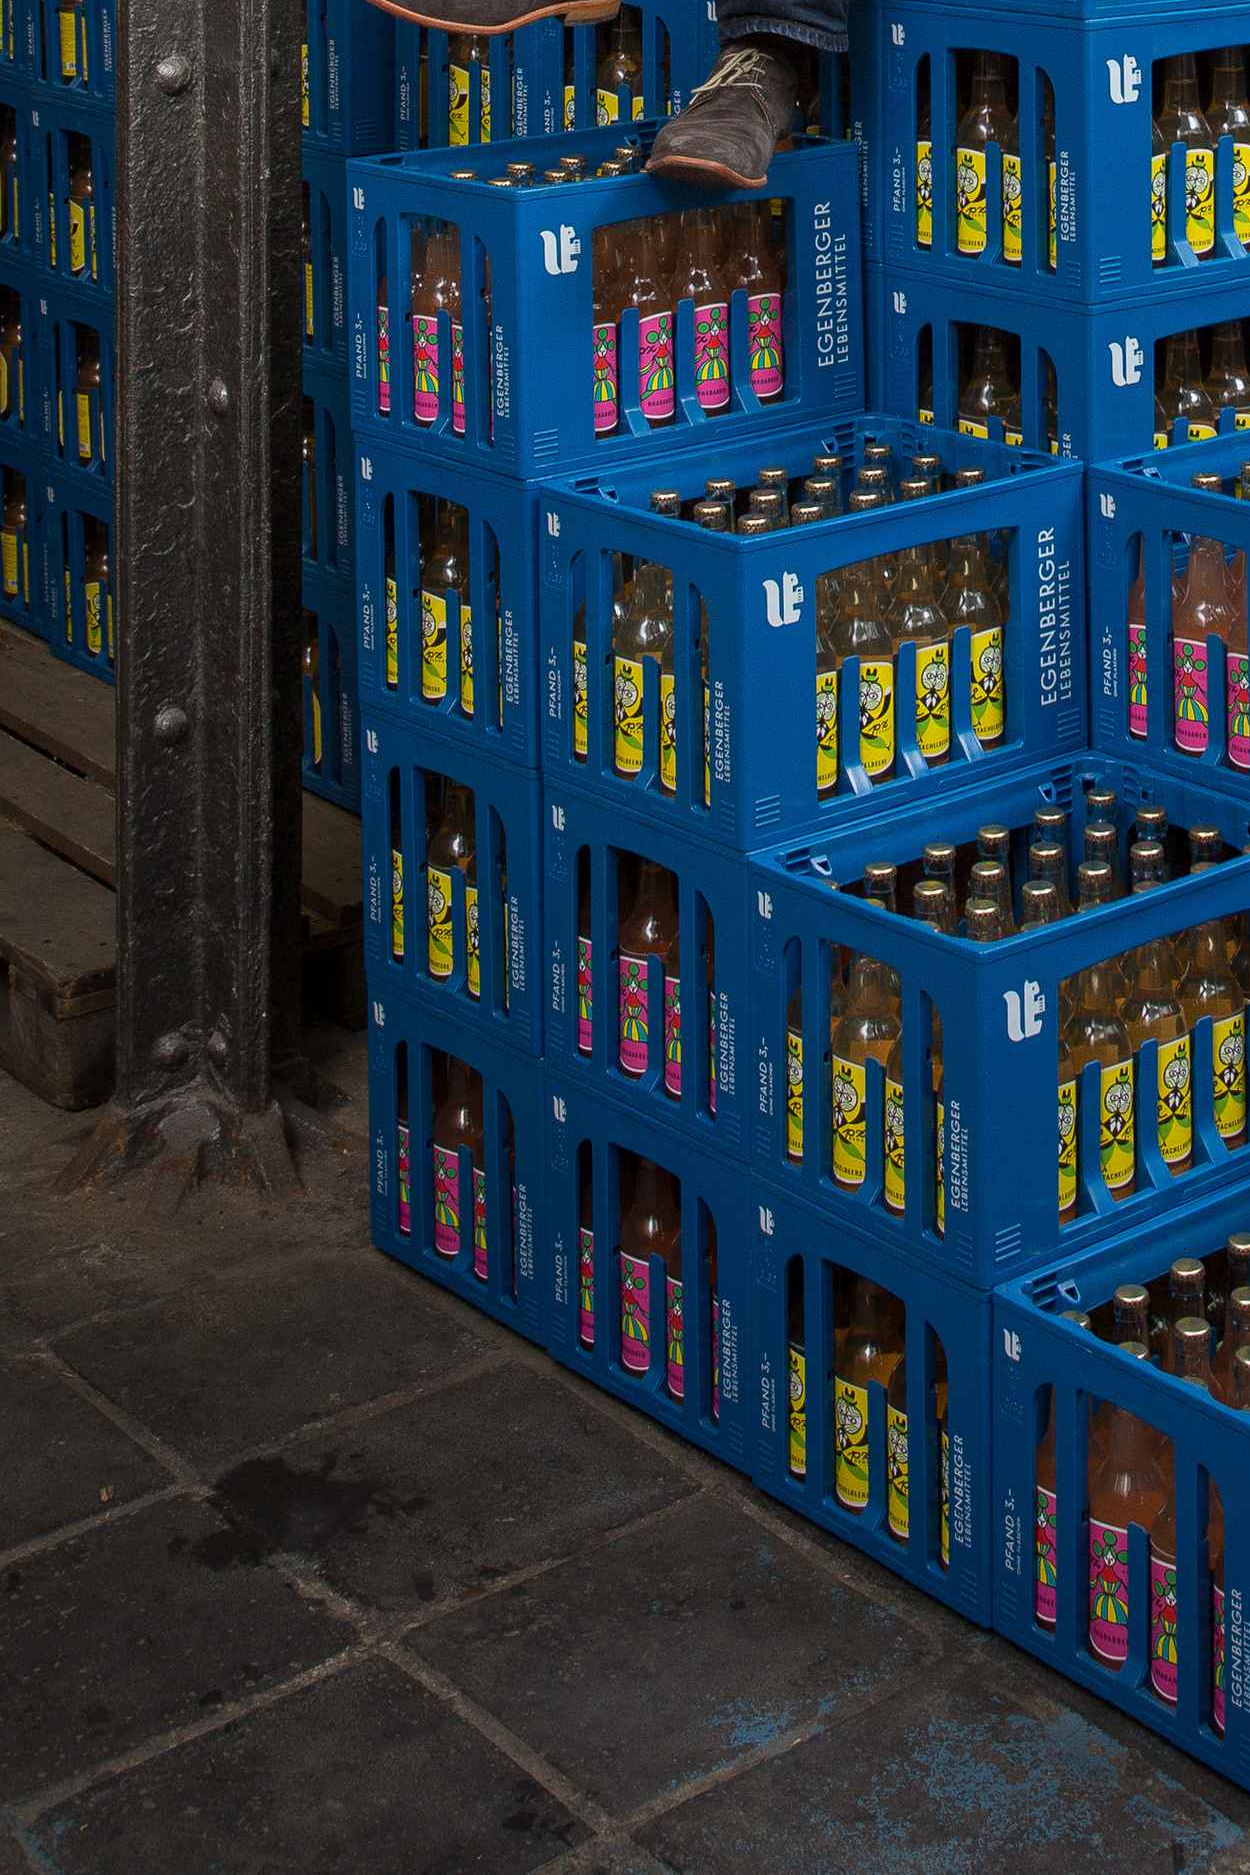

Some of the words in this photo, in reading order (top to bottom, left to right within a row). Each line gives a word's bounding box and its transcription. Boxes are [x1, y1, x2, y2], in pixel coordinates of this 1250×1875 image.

[1060, 151, 1069, 241] EGENBERGER
[814, 202, 834, 367] EGENBERGER
[835, 234, 848, 363] LEBENSMITTEL
[496, 325, 508, 416] EGENBERGER
[1038, 528, 1056, 705] EGENBERGER
[1058, 561, 1071, 699] LEBENSMITTEL
[1103, 649, 1111, 695] PFAND
[715, 681, 724, 780] EGENBERGER
[720, 993, 728, 1091] EGENBERGER
[951, 1101, 960, 1208] EGENBERGER
[762, 1377, 770, 1428] PFAND
[954, 1435, 964, 1543] EGENBERGER
[1005, 1515, 1014, 1570] PFAND
[1232, 1589, 1242, 1707] EGENBERGER
